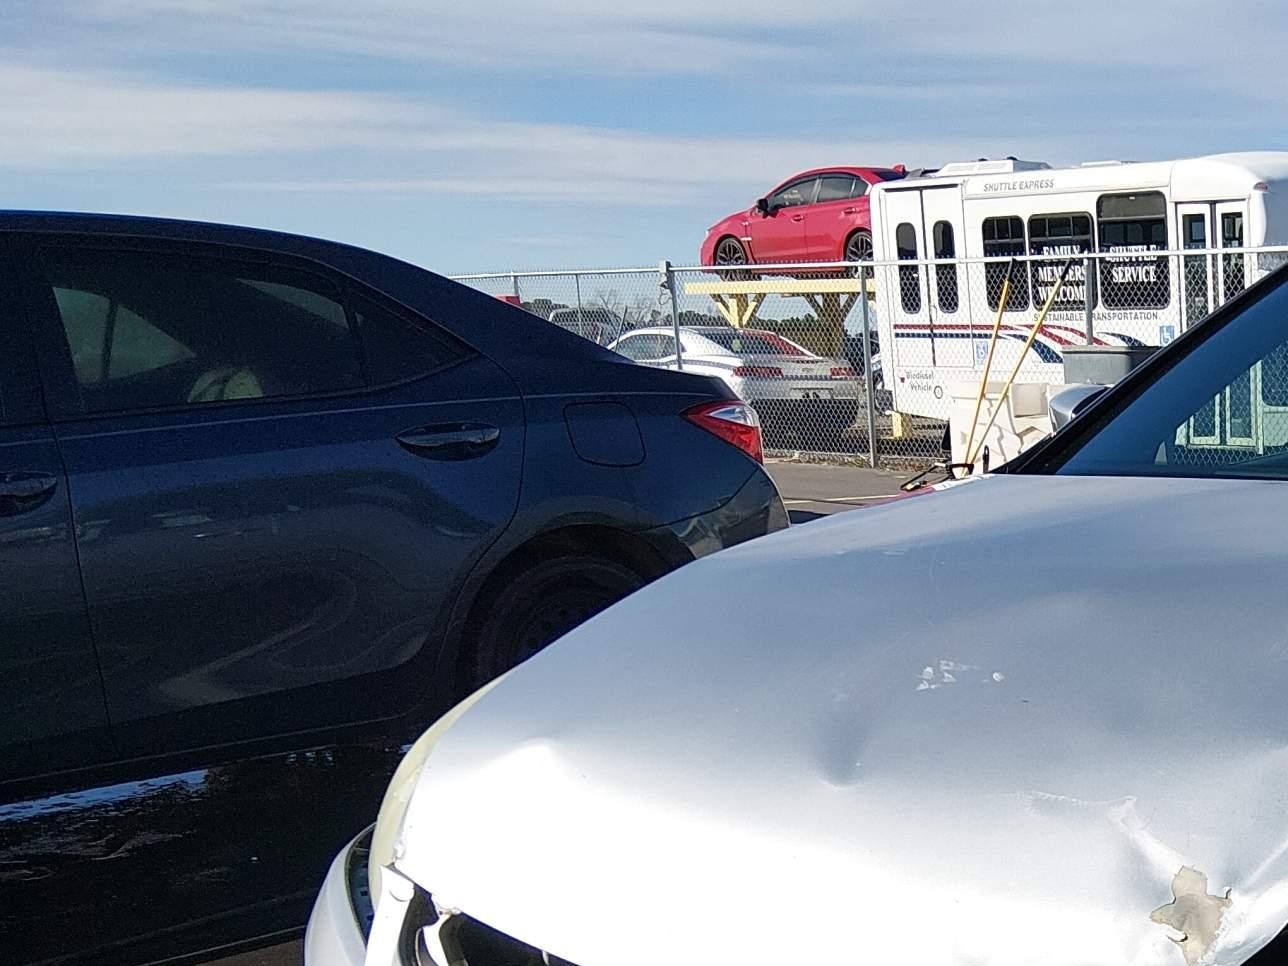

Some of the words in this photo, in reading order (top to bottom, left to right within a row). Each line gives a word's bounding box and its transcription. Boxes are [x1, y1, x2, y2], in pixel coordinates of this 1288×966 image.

[984, 181, 1018, 192] SHUTTLE
[1018, 178, 1055, 190] EXPRESS
[1112, 266, 1158, 282] SERVICE
[1038, 286, 1087, 301] WELCOM
[1033, 313, 1084, 322] SSTAINABLE
[1091, 311, 1159, 320] RANSPORTATION
